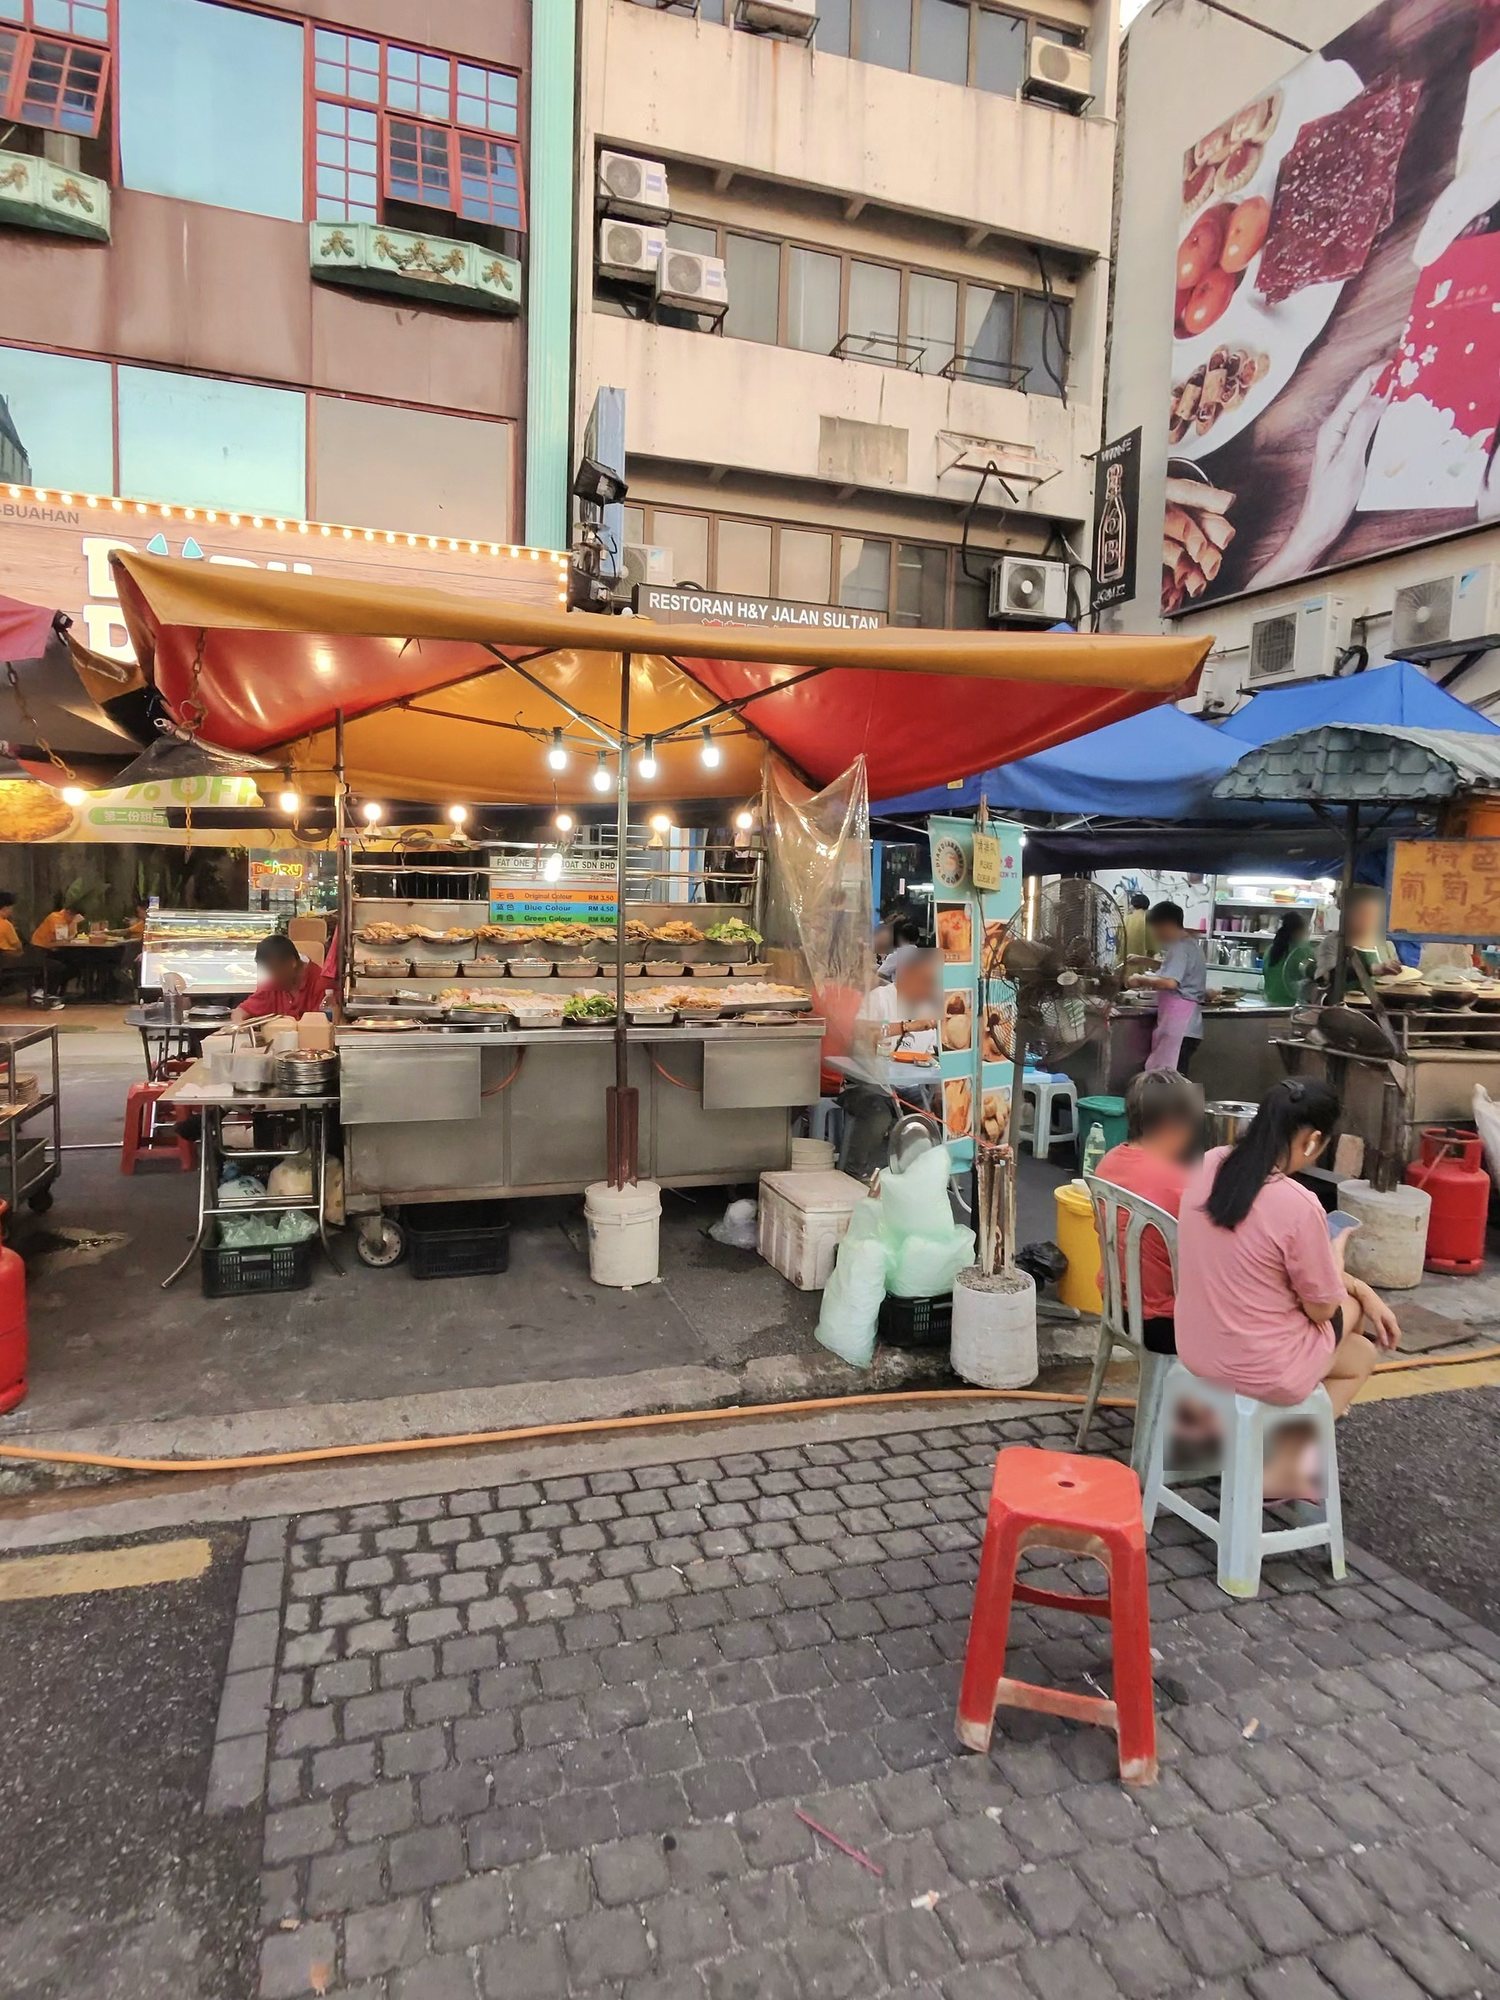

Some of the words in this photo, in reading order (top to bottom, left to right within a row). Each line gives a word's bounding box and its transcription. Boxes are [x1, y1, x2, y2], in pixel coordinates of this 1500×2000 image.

[649, 592, 734, 617] RESTORAN
[737, 602, 769, 620] H&Y
[771, 606, 819, 626] JALAN
[822, 612, 879, 629] SULTAN
[497, 859, 510, 867] FAT
[514, 859, 529, 867] ONE
[582, 860, 597, 869] SDN
[600, 861, 616, 870] BHD
